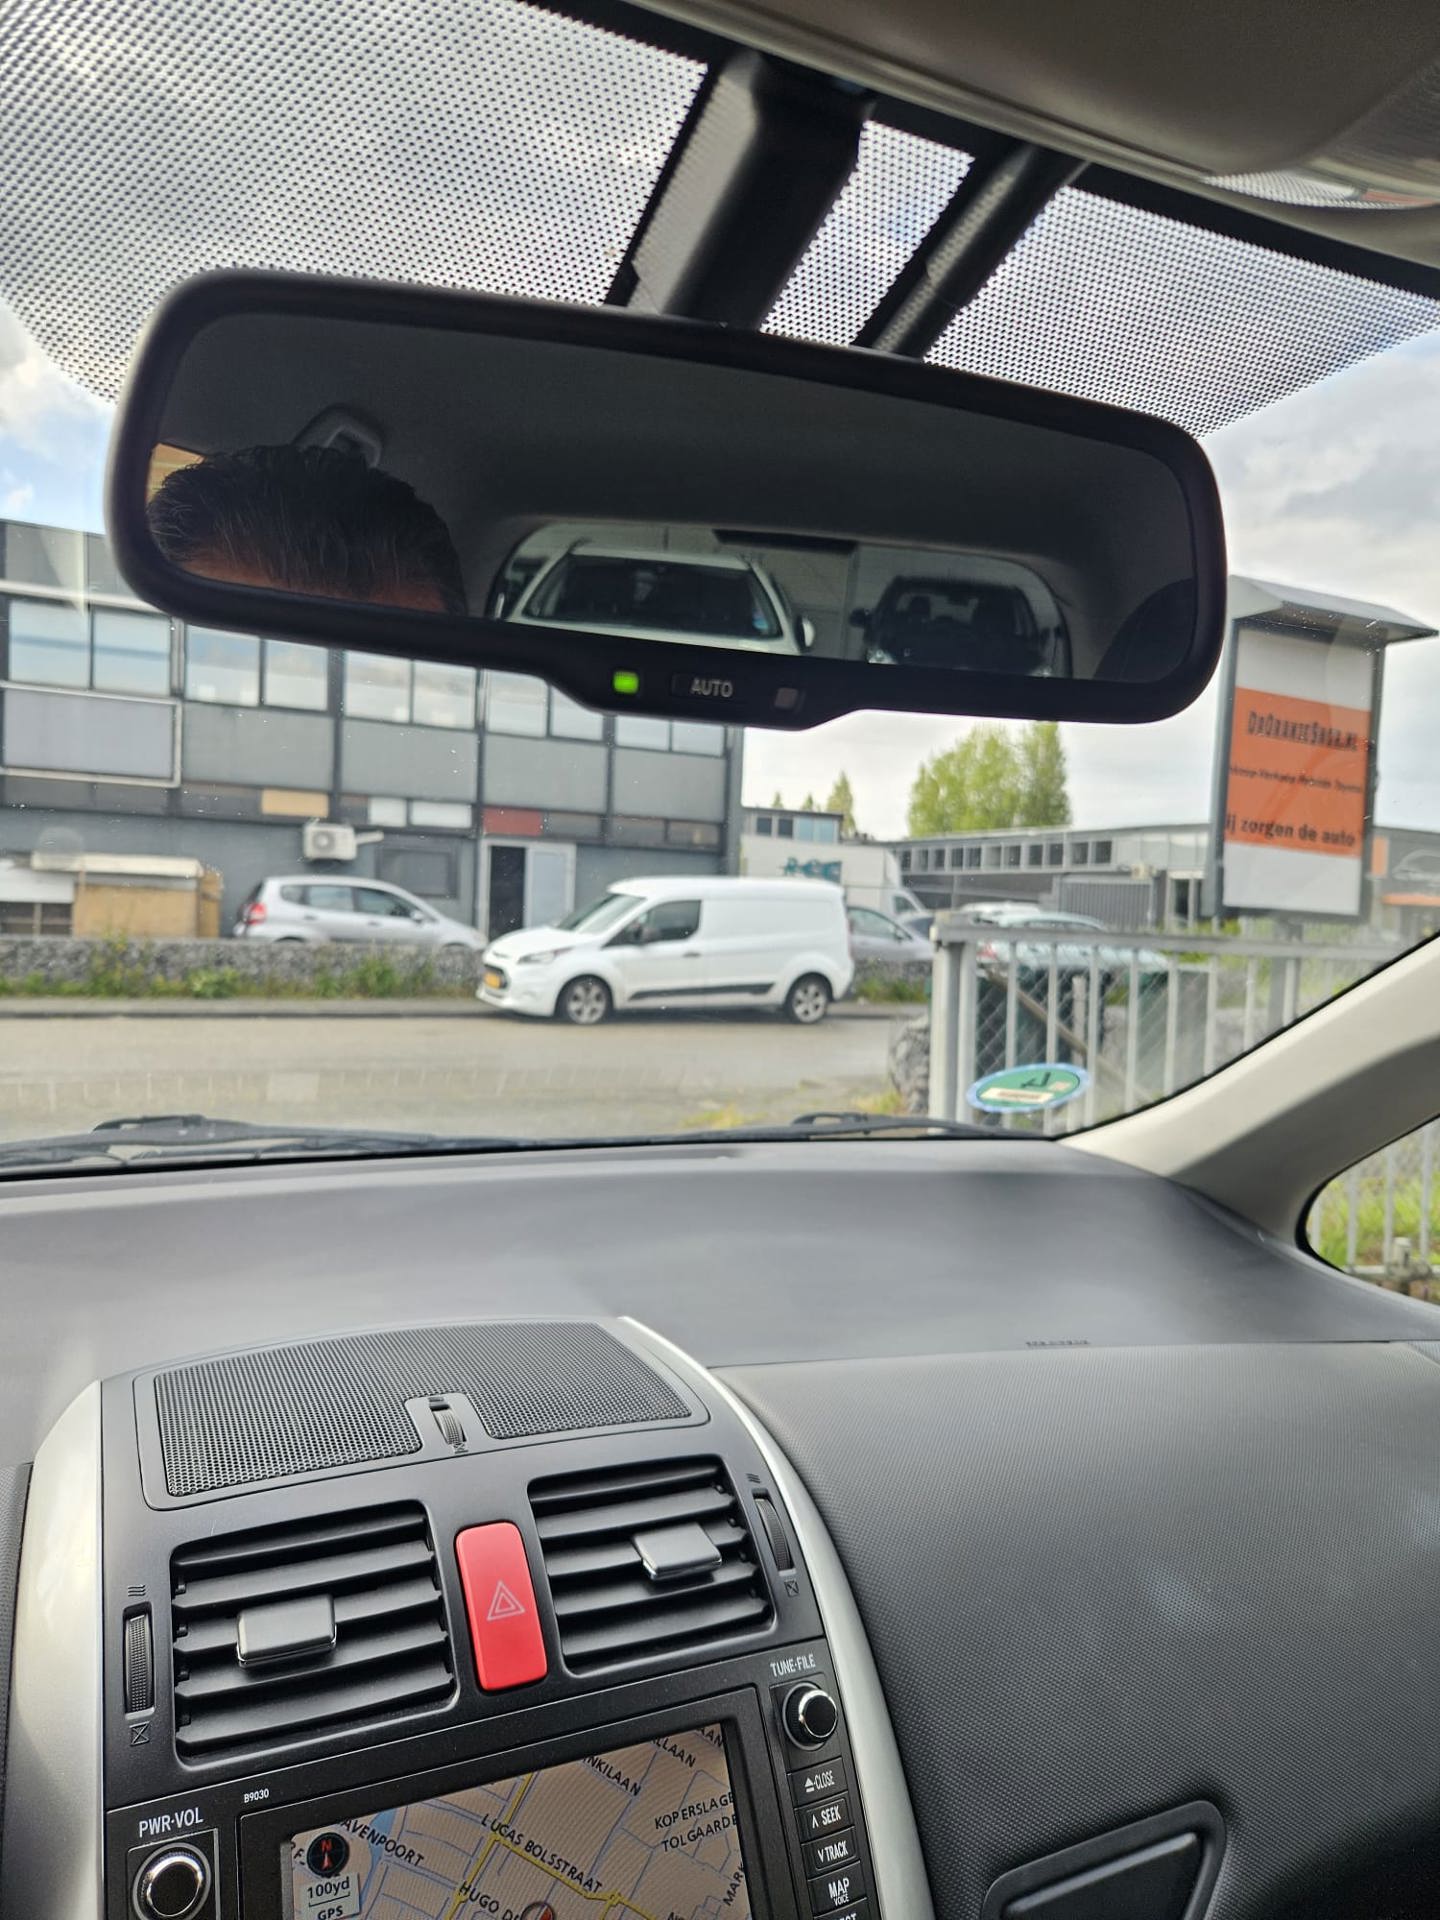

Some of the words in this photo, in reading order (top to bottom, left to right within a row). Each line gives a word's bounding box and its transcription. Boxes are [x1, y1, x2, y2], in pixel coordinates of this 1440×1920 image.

[690, 677, 733, 698] AUTO
[1241, 819, 1295, 840] zorgen
[1298, 823, 1318, 842] de
[653, 1737, 696, 1768] LLAAN
[814, 1770, 835, 1791] CLOSE
[243, 1788, 270, 1804] B9030
[820, 1805, 842, 1826] SEEK
[481, 1813, 525, 1846] LUCAS
[524, 1839, 603, 1894] BOLSSTRAAT
[825, 1840, 849, 1862] TRACK
[307, 1875, 350, 1899] 100yd
[459, 1881, 500, 1913] HUGO
[828, 1877, 850, 1899] MAP
[317, 1905, 344, 1920] GPS
